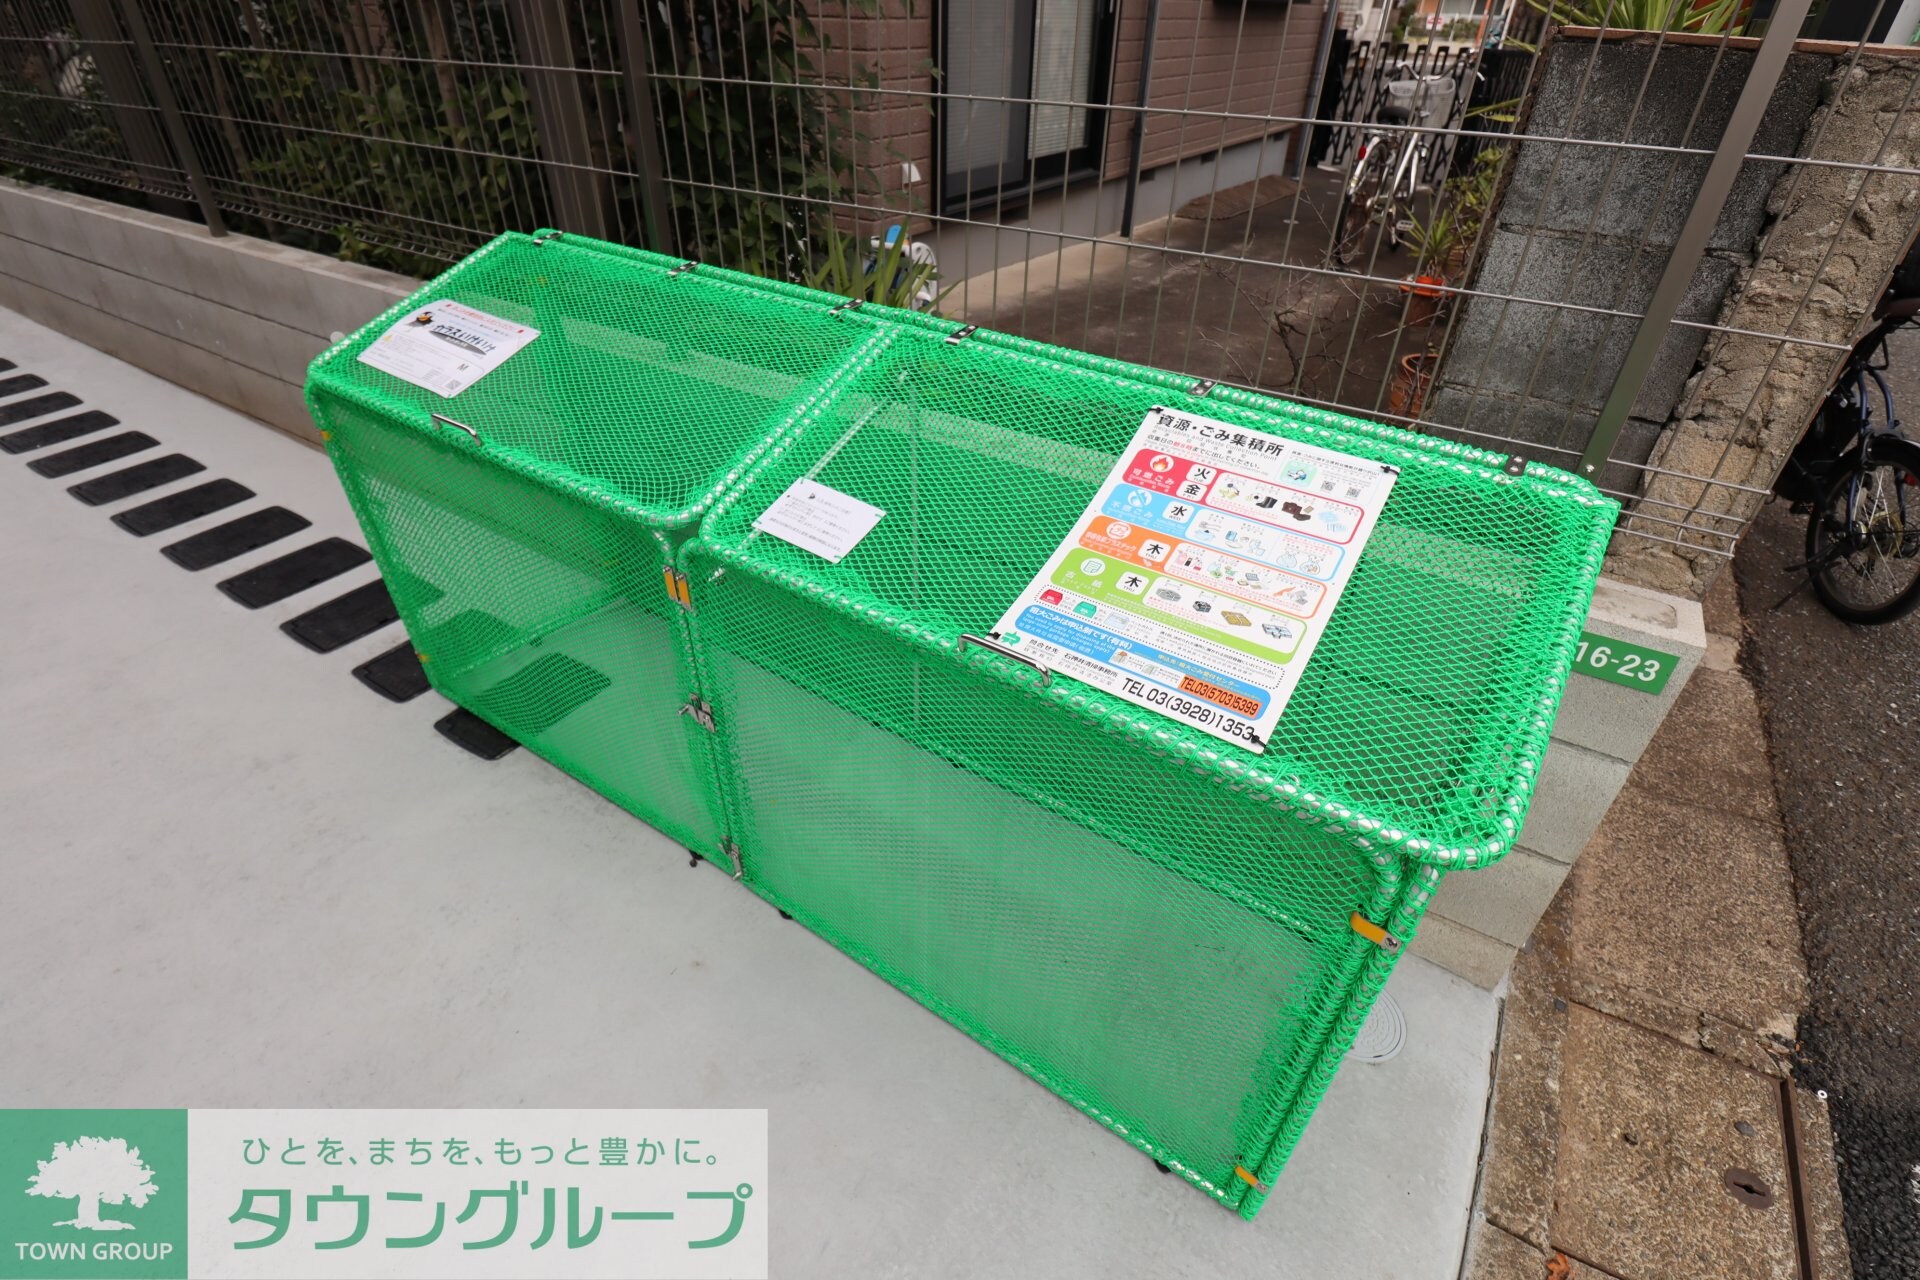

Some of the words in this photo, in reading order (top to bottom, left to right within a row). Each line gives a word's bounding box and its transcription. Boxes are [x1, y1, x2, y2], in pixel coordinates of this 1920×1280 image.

[1157, 414, 1284, 457] 資源・ごみ集積所
[1194, 468, 1211, 480] 火
[1184, 484, 1201, 496] 金
[1170, 505, 1188, 517] 水
[1146, 543, 1163, 555] 木
[1124, 576, 1142, 588] 木
[1575, 641, 1661, 682] 16-23
[1182, 676, 1259, 716] TEL03(5703)5399
[1121, 677, 1144, 698] TEL
[1147, 688, 1255, 741] 03(3928)1353
